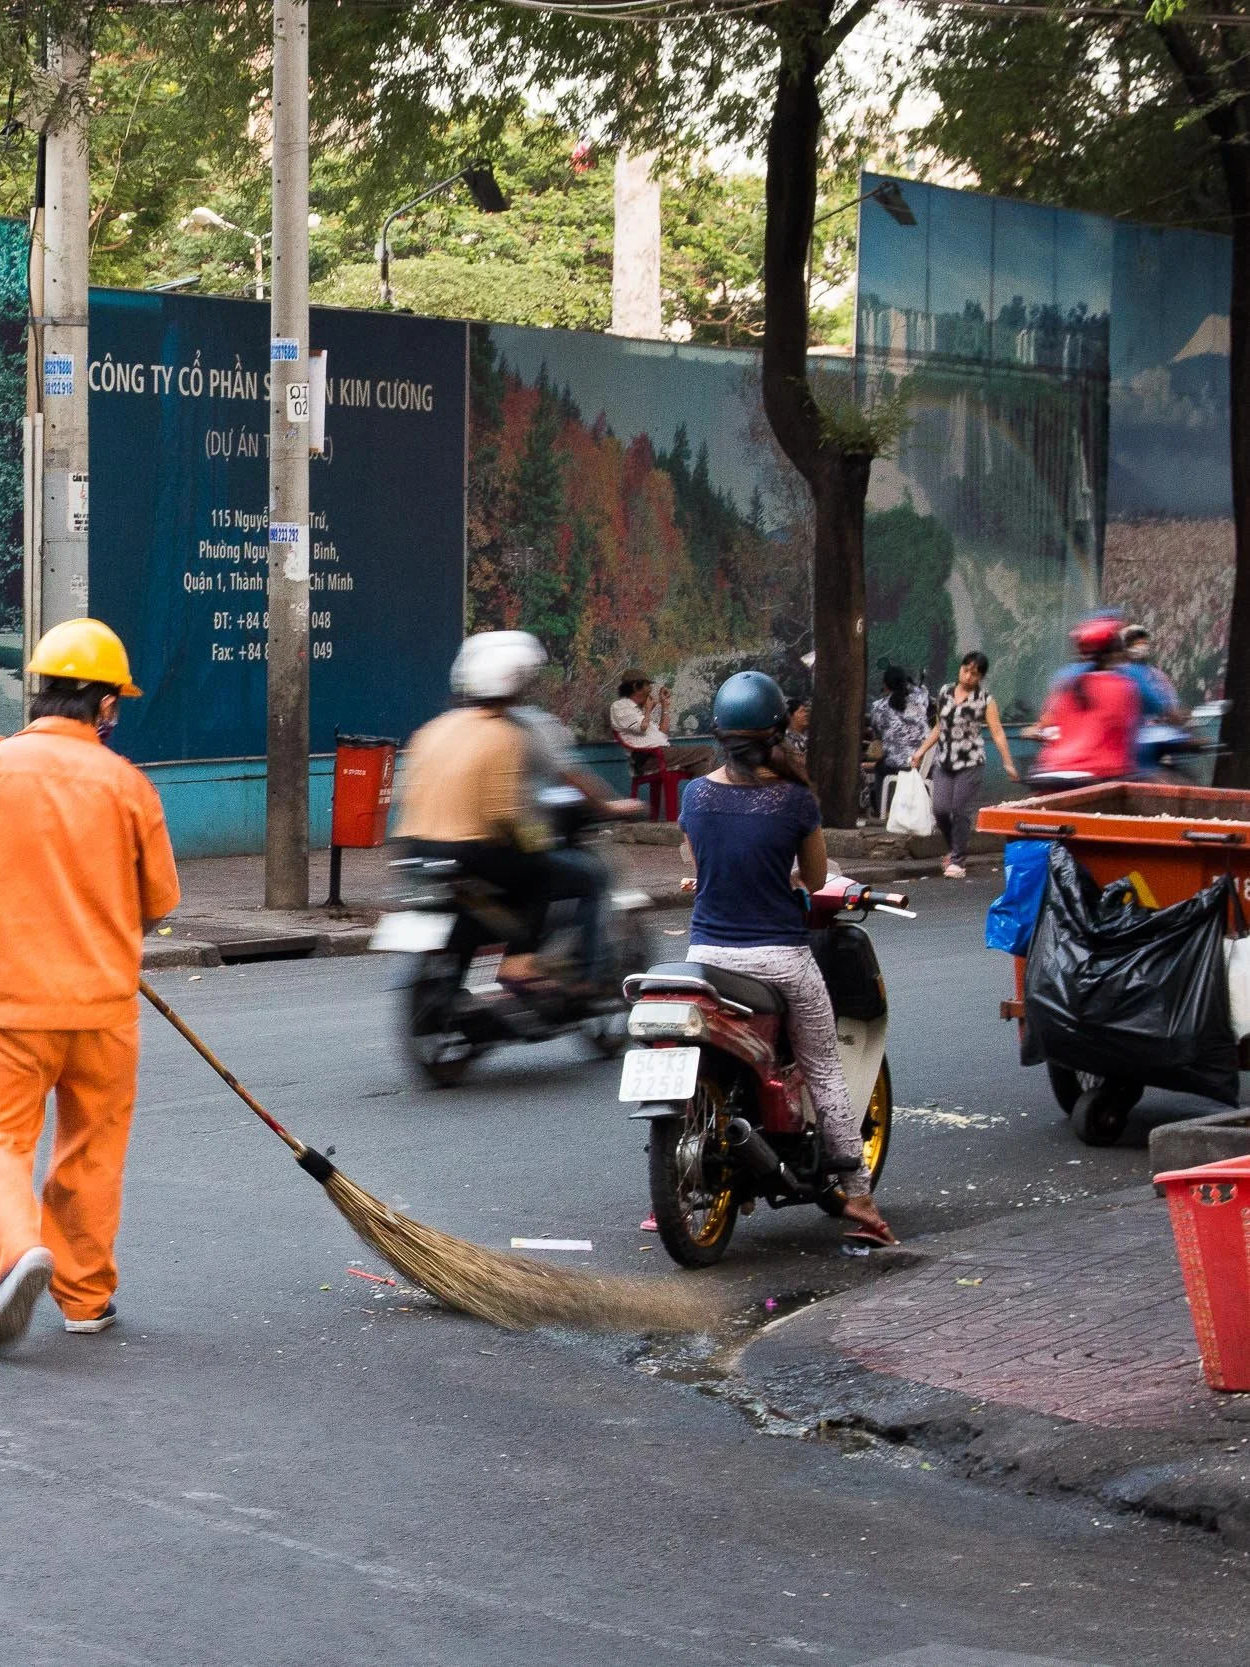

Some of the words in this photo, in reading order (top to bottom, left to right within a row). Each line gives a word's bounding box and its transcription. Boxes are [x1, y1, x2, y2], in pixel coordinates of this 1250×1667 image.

[88, 352, 145, 394] CÔNG
[150, 365, 174, 395] TY
[178, 349, 204, 397] CỔ
[209, 353, 258, 401] PHẦN
[340, 378, 371, 408] KIM
[376, 378, 434, 412] CƯƠNG
[290, 385, 308, 400] QT
[294, 400, 309, 416] 02
[205, 428, 234, 462] (DỰ
[236, 424, 259, 458] ÁN
[211, 509, 231, 528] 115
[235, 506, 270, 534] Nguyễ
[199, 540, 240, 564] Phường
[244, 541, 270, 564] Nguy
[183, 571, 213, 595] Quận
[217, 572, 227, 593] 1,
[230, 571, 264, 591] Thành
[309, 572, 325, 591] Chí
[327, 572, 354, 591] Minh
[214, 611, 232, 629] ĐT:
[237, 611, 261, 629] +84
[311, 611, 331, 629] 048
[856, 618, 863, 634] 6
[212, 643, 234, 661] Fax:
[239, 643, 262, 660] +84
[313, 641, 333, 659] 049
